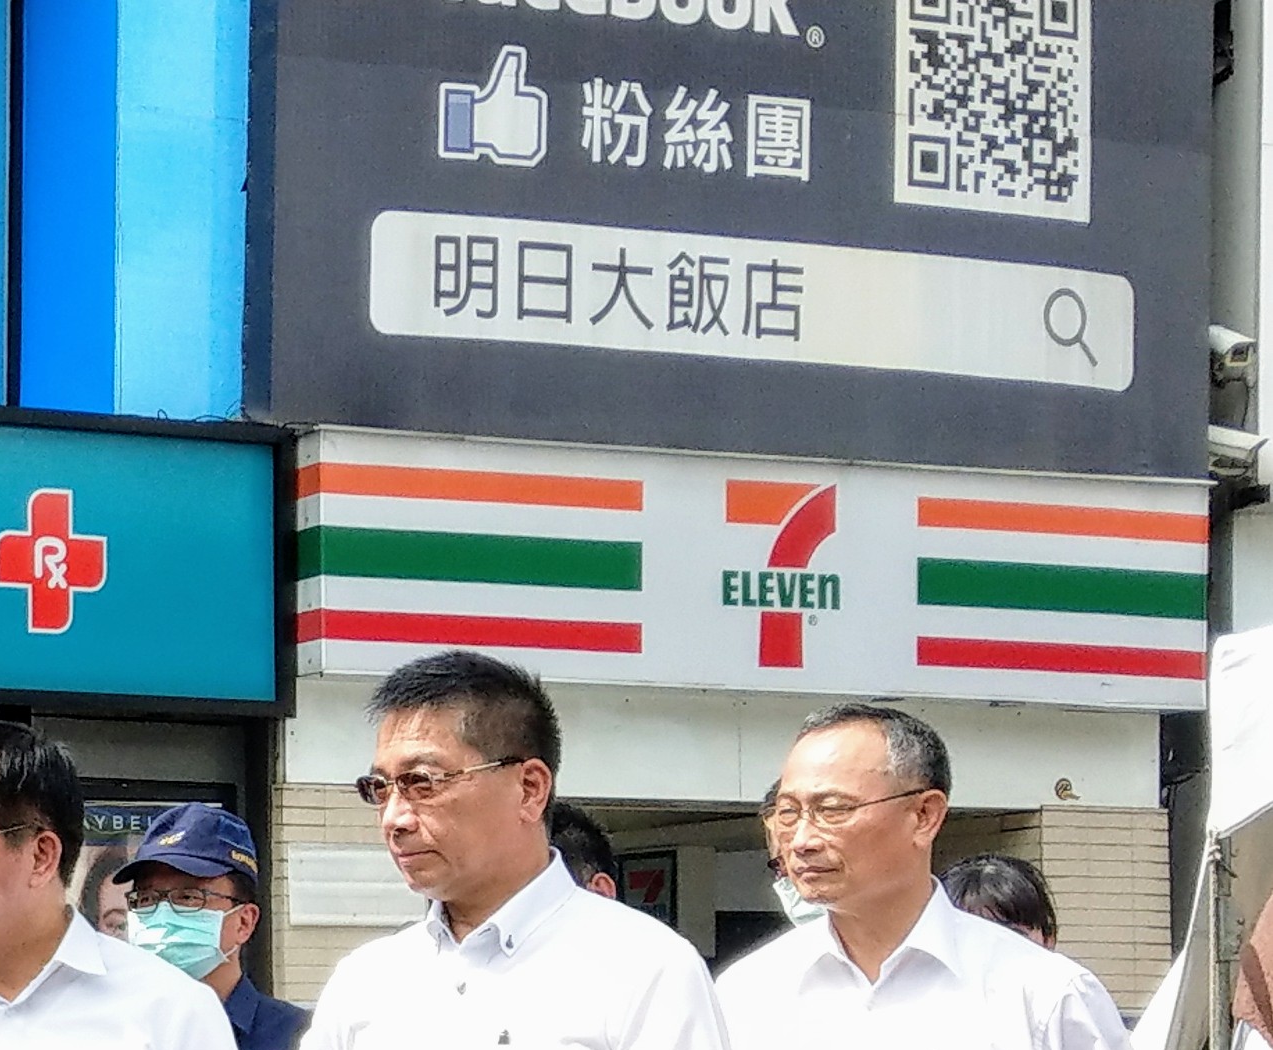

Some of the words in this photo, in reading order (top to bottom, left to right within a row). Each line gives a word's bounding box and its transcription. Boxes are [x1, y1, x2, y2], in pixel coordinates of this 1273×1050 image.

[582, 77, 811, 182] 粉絲團
[433, 233, 805, 343] 明日大飯店
